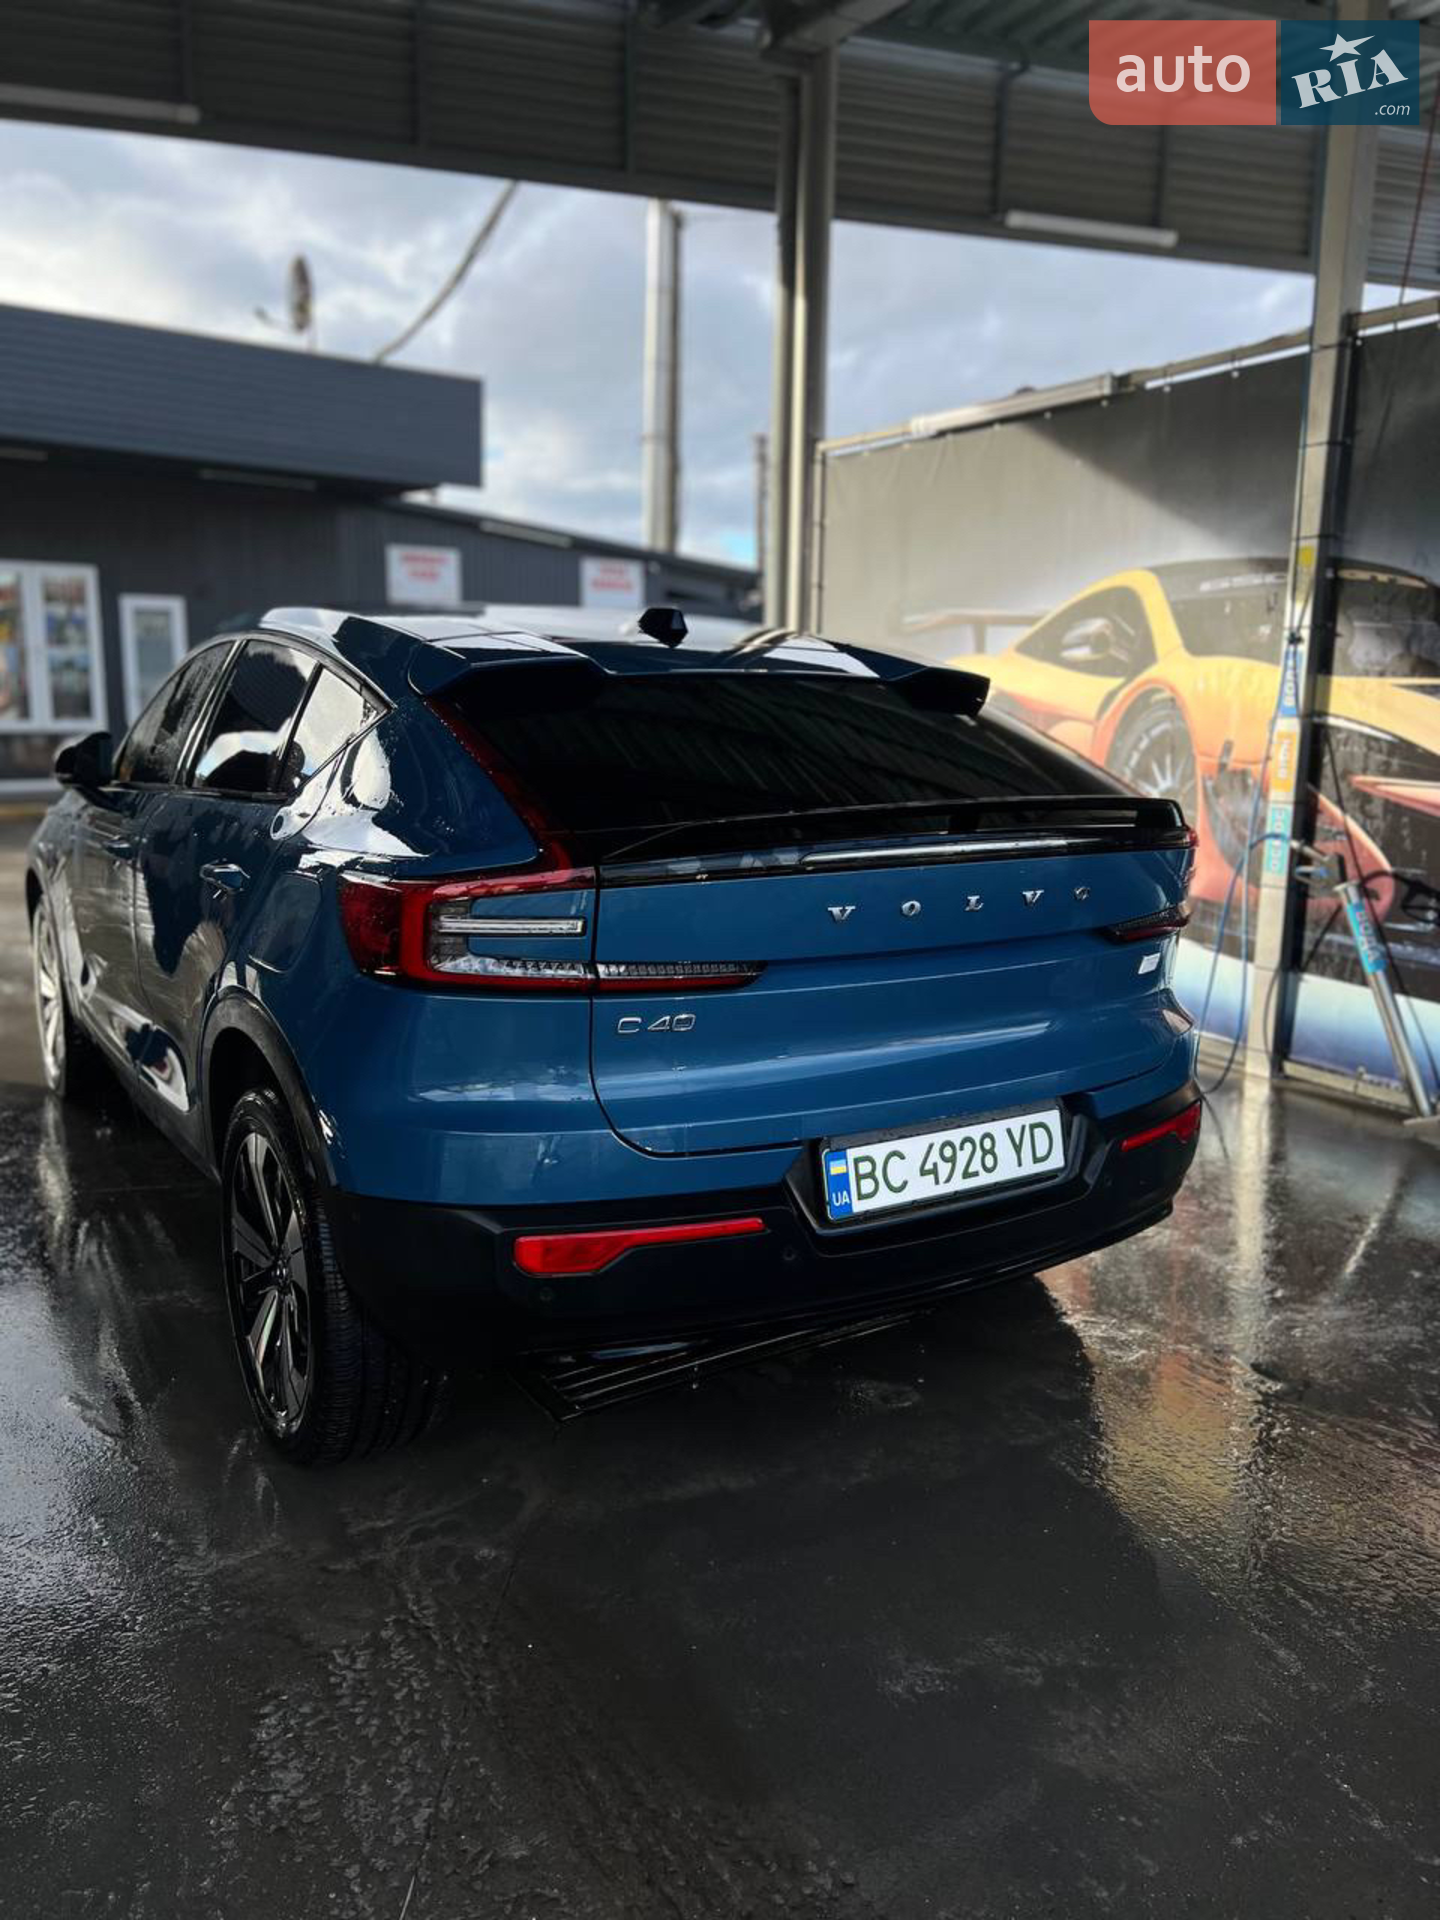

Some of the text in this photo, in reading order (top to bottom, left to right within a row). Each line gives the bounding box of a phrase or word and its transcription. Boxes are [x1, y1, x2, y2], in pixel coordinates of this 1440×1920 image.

[827, 885, 1091, 923] VOLVO
[853, 1120, 1054, 1201] BC 4928 YD
[832, 1190, 851, 1207] UA
